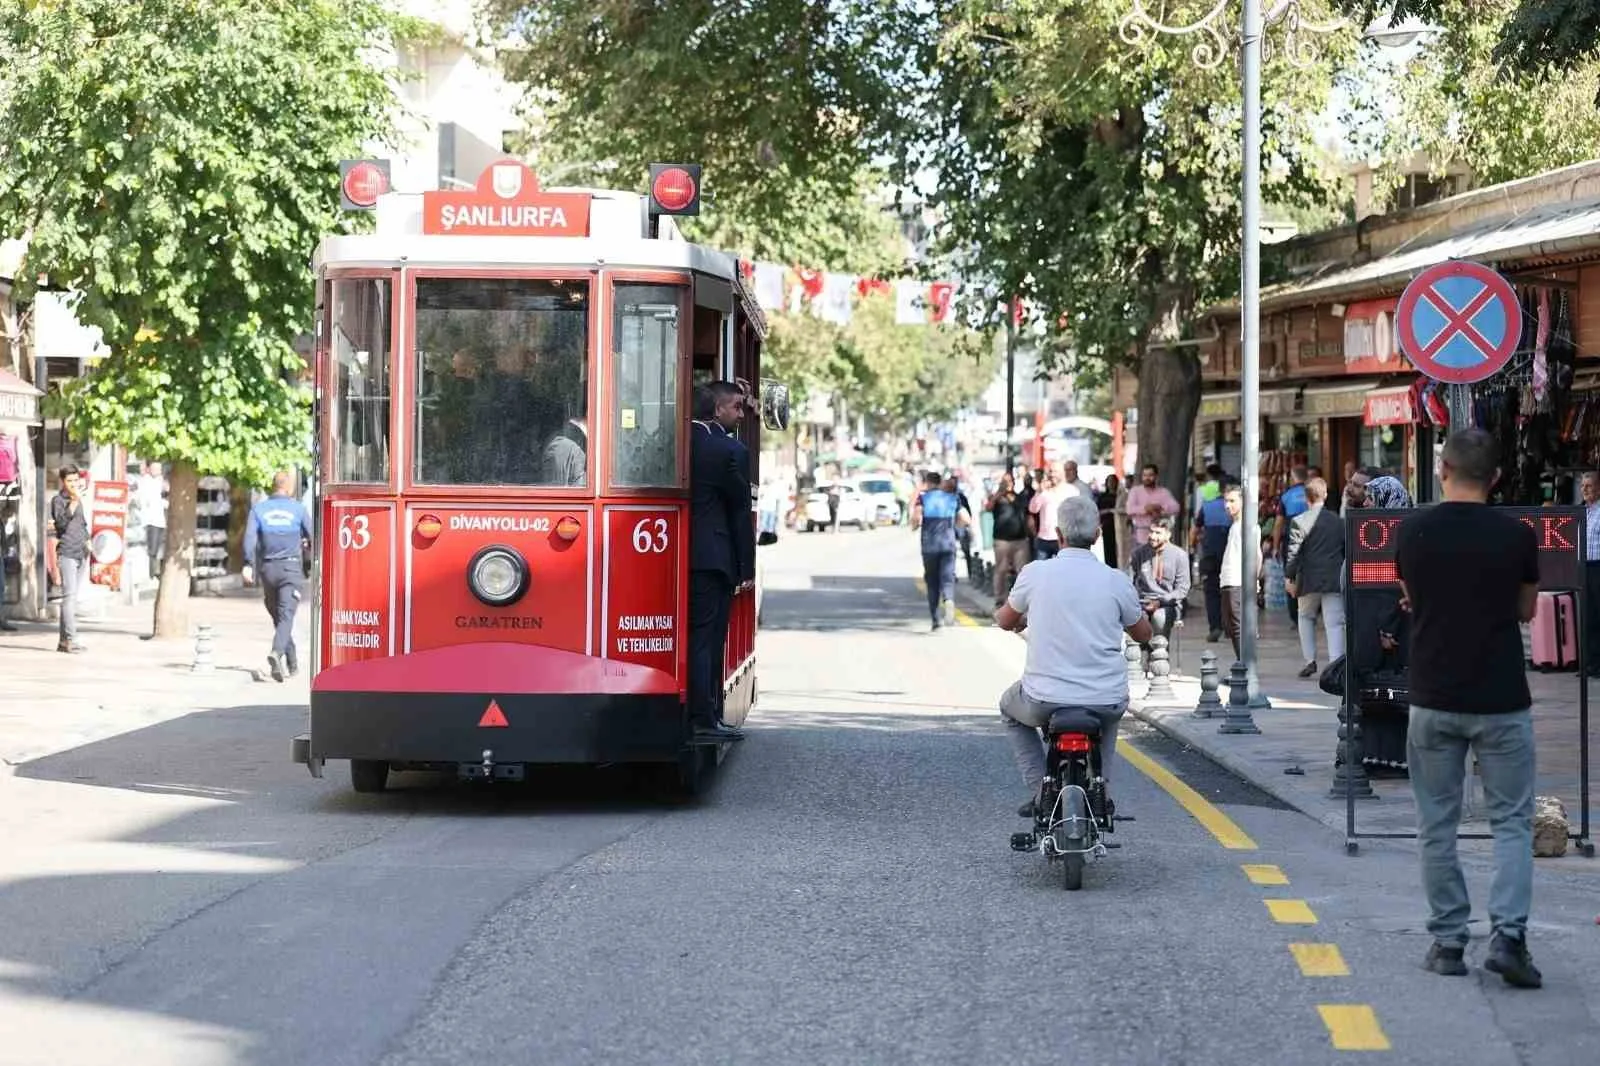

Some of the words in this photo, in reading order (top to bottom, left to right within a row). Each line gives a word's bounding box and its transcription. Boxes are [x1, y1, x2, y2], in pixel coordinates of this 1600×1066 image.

[440, 204, 567, 231] ŞANLIURFA
[450, 513, 550, 531] DİVANYOLU-02
[338, 513, 371, 550] 63
[632, 518, 669, 553] 63
[354, 611, 379, 626] YASAK
[455, 616, 543, 629] GARATREN
[618, 616, 655, 631] ASILMAK
[617, 638, 628, 653] VE
